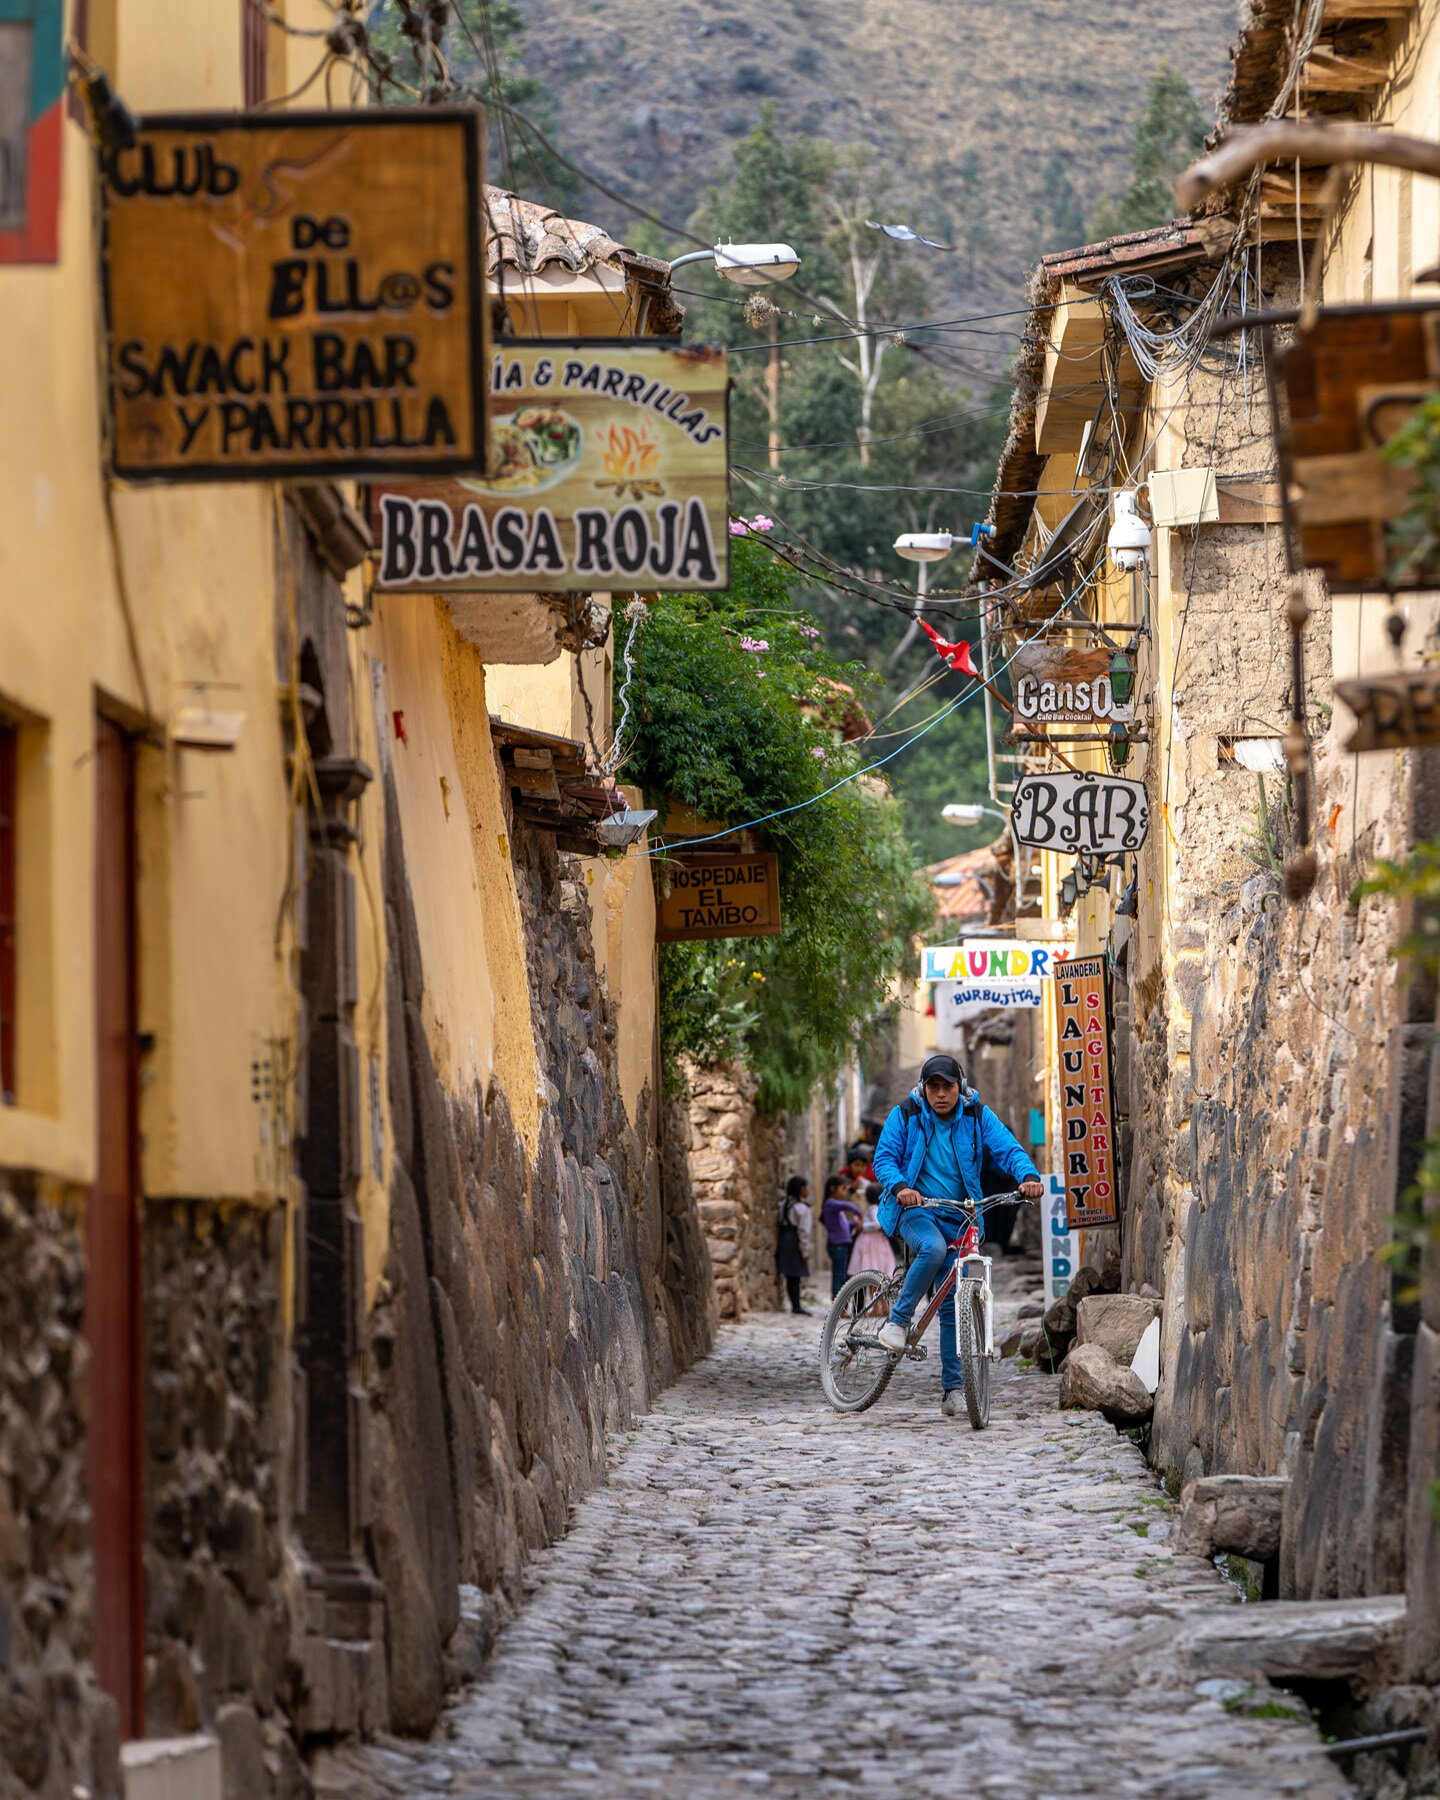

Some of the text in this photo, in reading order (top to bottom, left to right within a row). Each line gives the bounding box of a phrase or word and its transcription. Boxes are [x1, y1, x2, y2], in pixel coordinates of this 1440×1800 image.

[118, 331, 417, 397] SNACK BAR
[176, 395, 456, 454] Y PARRILLA
[534, 359, 552, 386] &
[563, 361, 721, 443] PARRILLAS
[384, 498, 717, 582] BRASA ROJA
[1065, 712, 1092, 721] Cocktail
[1020, 781, 1139, 849] BAR
[669, 865, 765, 888] HOSPEDAJE
[699, 888, 732, 907] EL
[679, 906, 758, 927] TAMBO
[1055, 962, 1101, 980] LAVANDERIA
[1061, 983, 1091, 1209] LAUNDRY
[1086, 993, 1111, 1198] SAGITARIO
[1079, 1208, 1103, 1216] SERVICE
